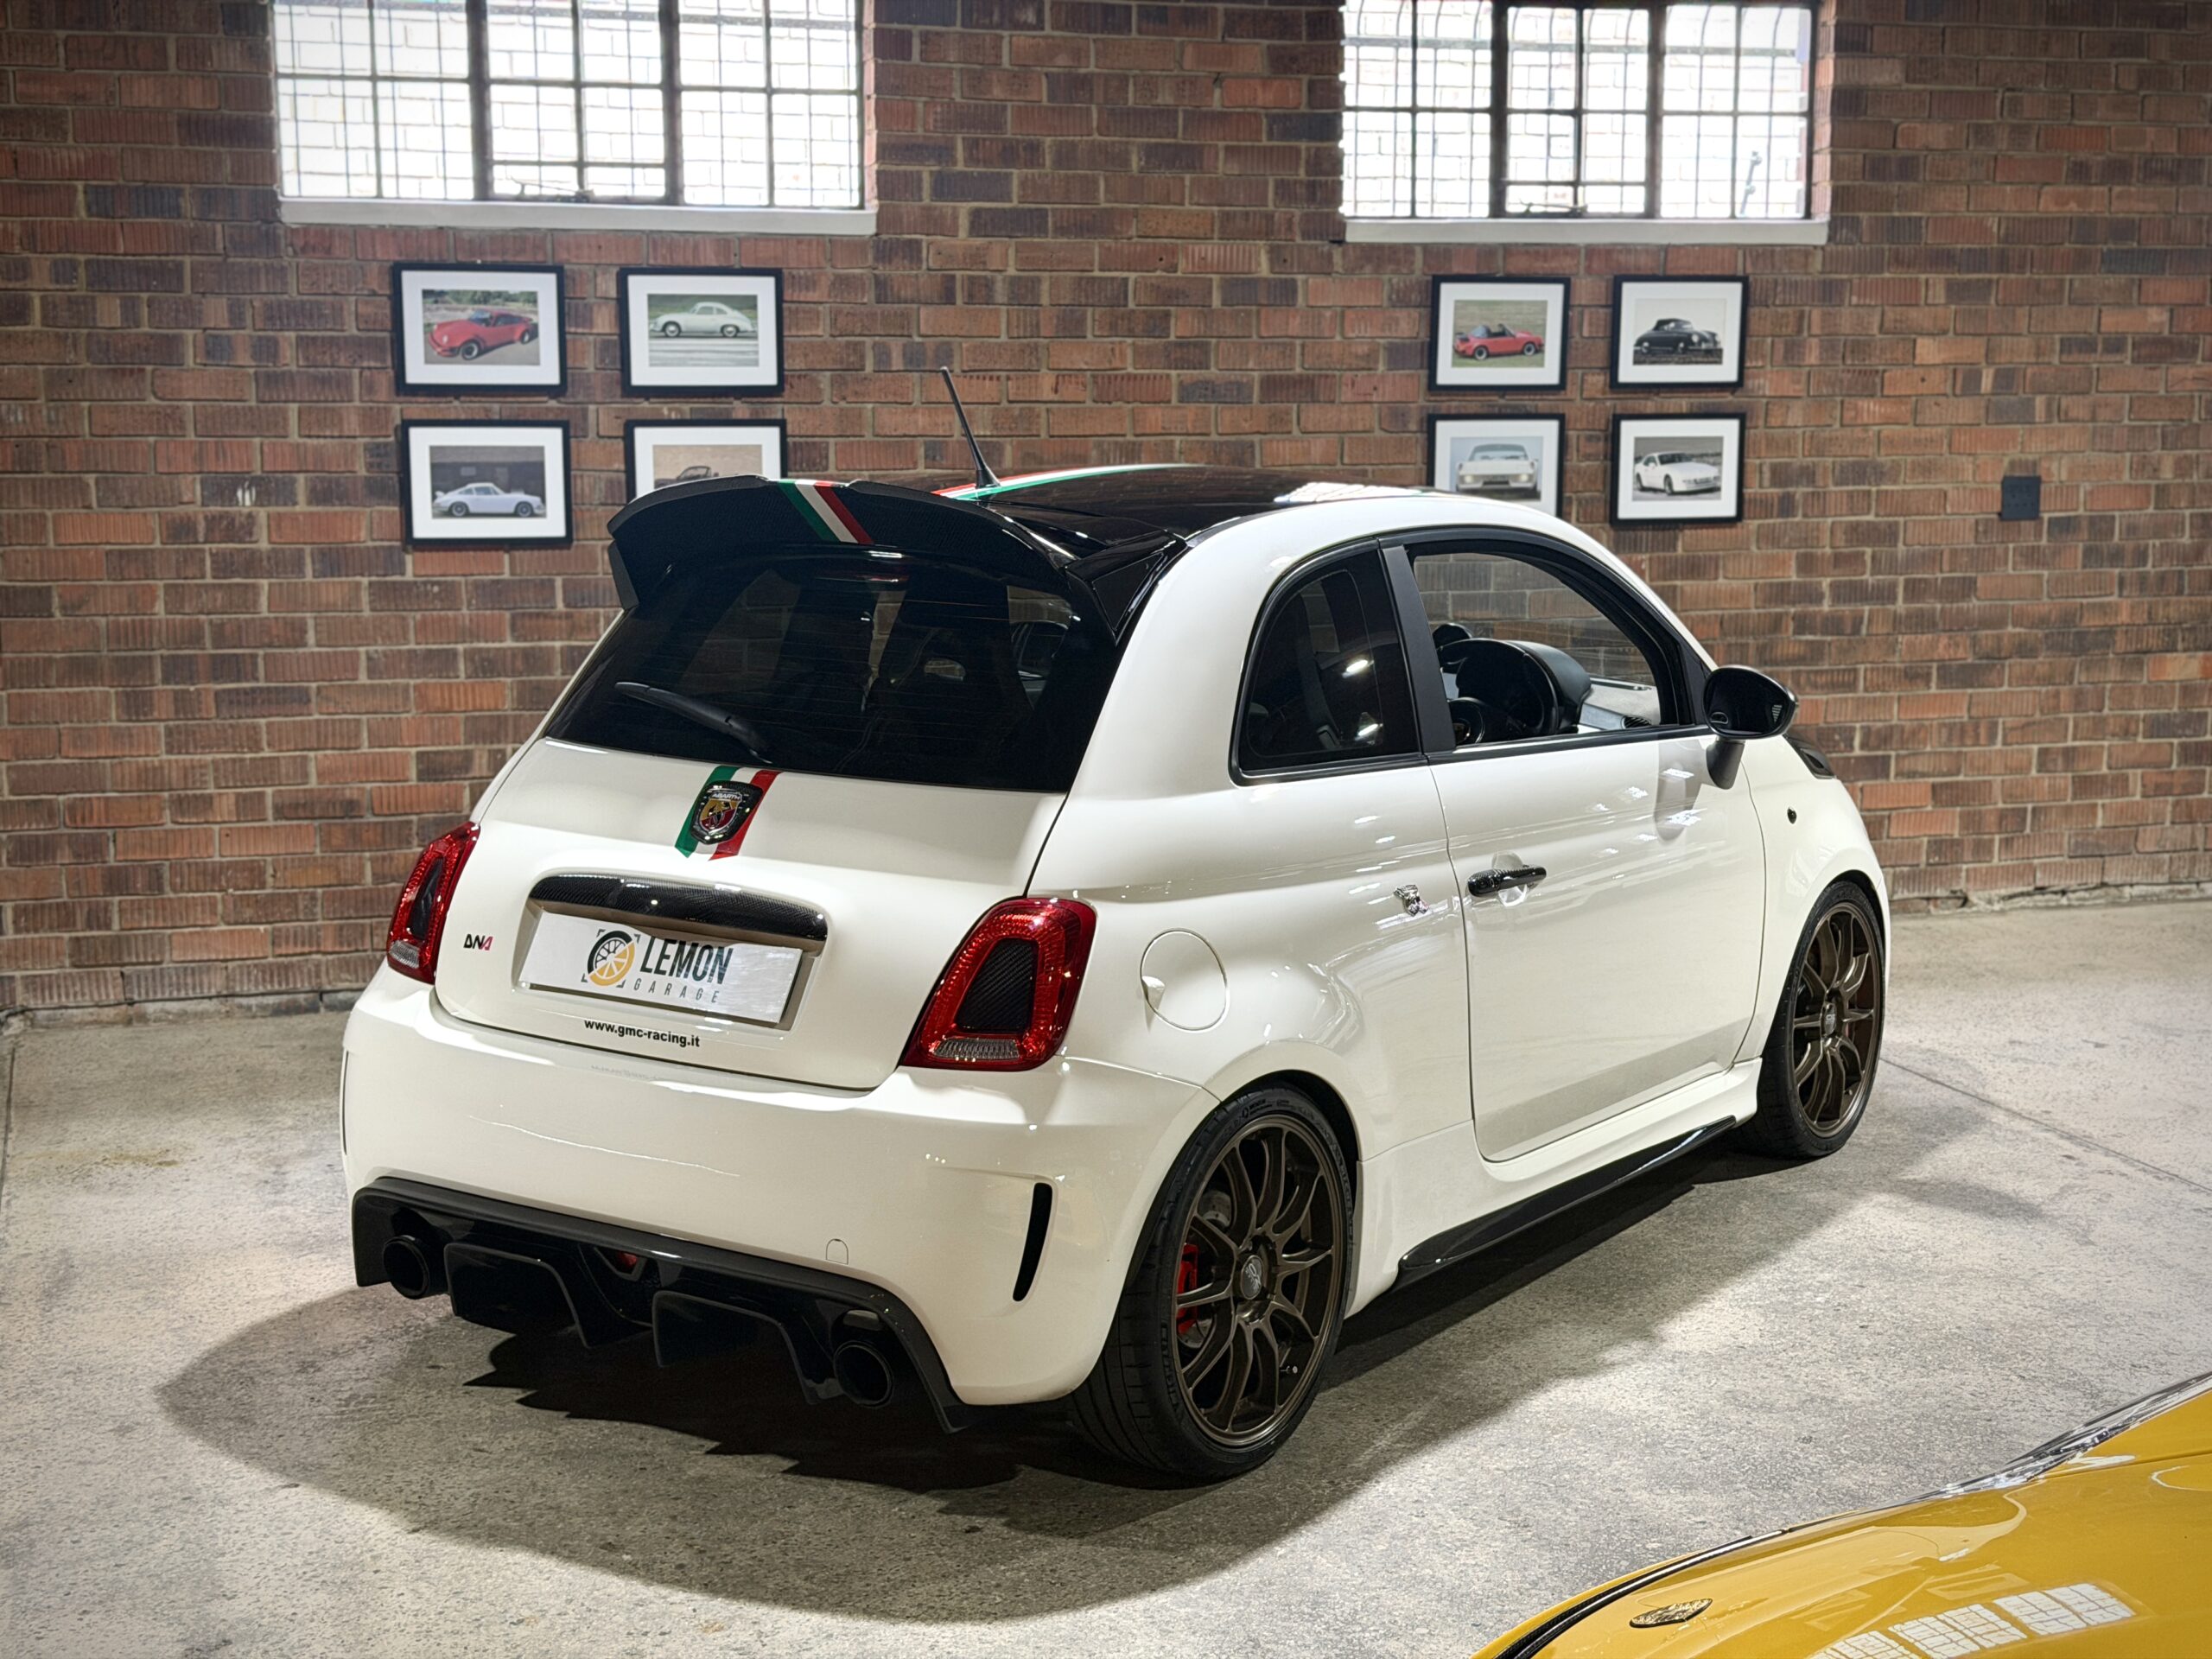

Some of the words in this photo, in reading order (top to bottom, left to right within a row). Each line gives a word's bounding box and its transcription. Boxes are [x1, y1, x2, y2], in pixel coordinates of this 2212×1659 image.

[639, 936, 734, 984] LEMON
[633, 978, 719, 1003] GARAGE
[584, 1020, 701, 1047] www.gmc-racing.it
